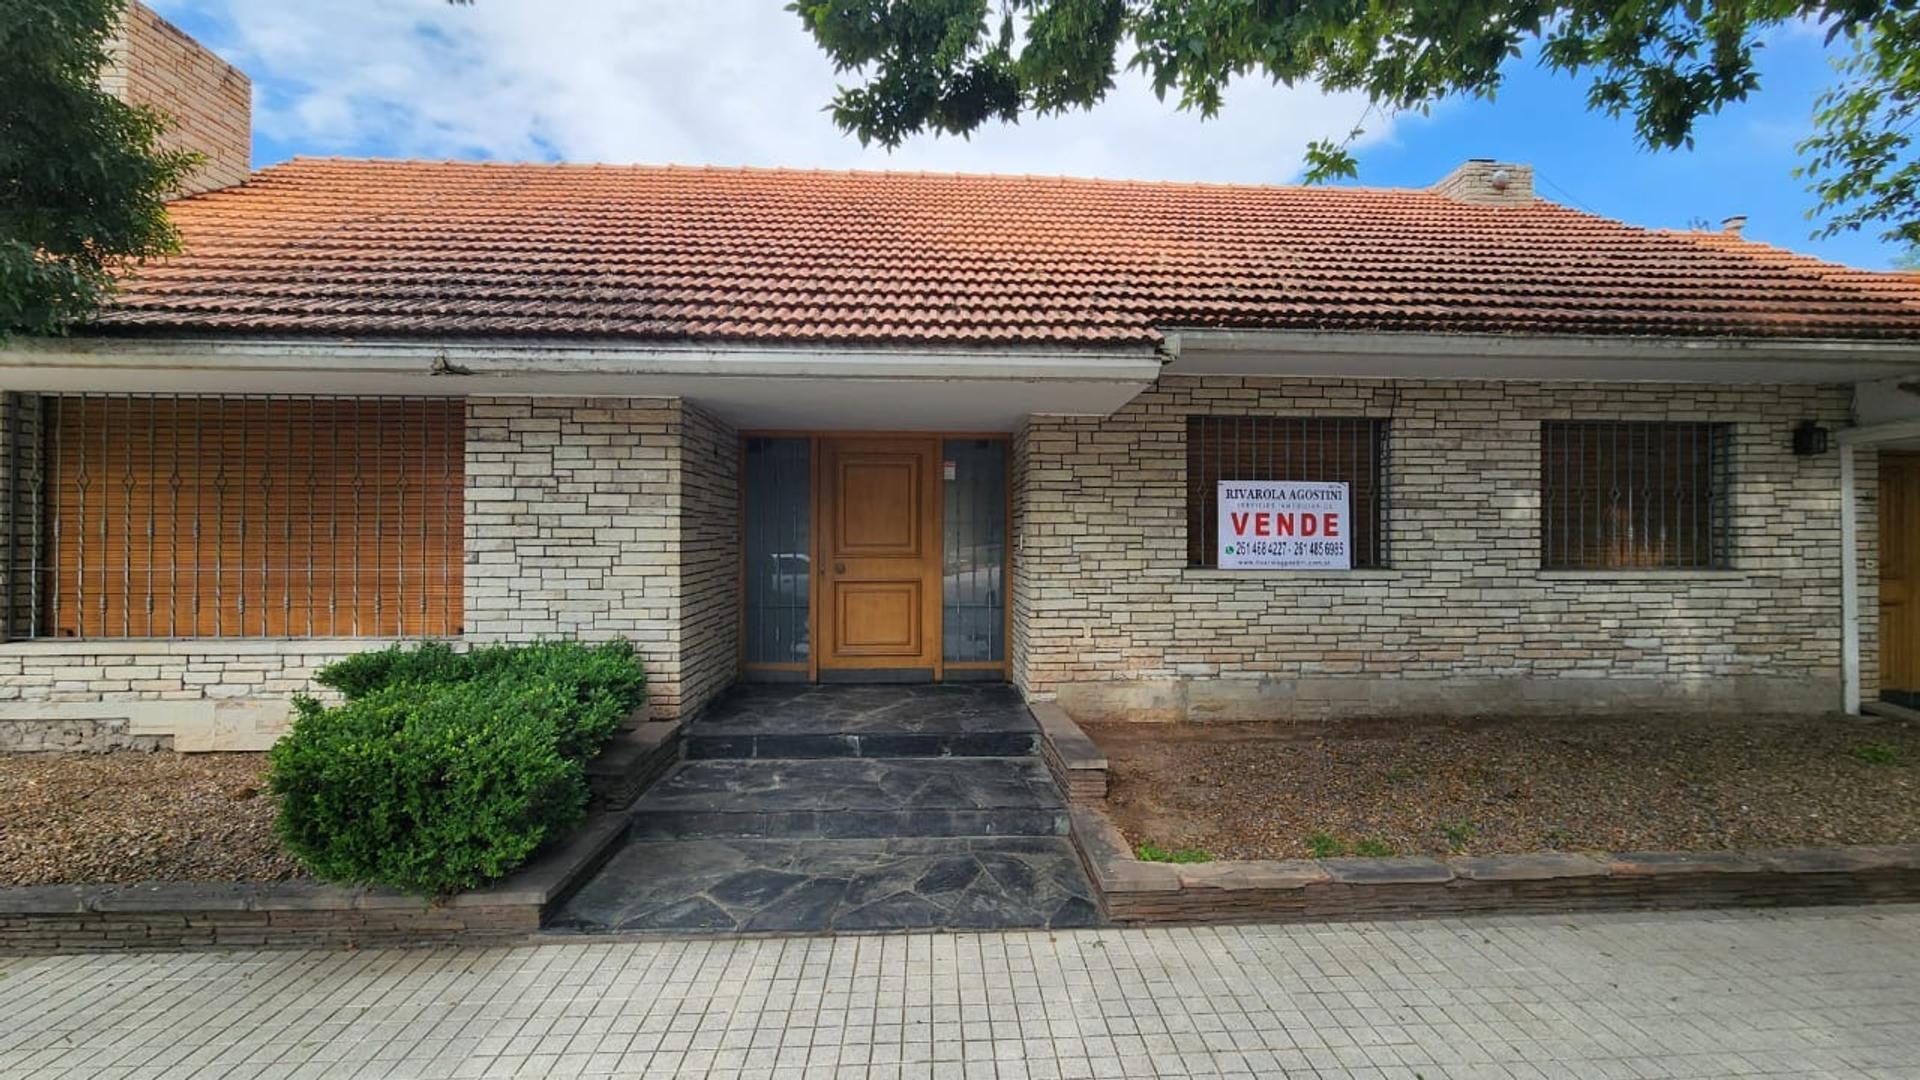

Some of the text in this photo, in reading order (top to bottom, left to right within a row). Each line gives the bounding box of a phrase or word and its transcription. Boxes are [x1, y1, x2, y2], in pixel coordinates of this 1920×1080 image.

[1225, 488, 1342, 501] RIVAROLA AGOSTINI
[1231, 512, 1339, 537] VENDE
